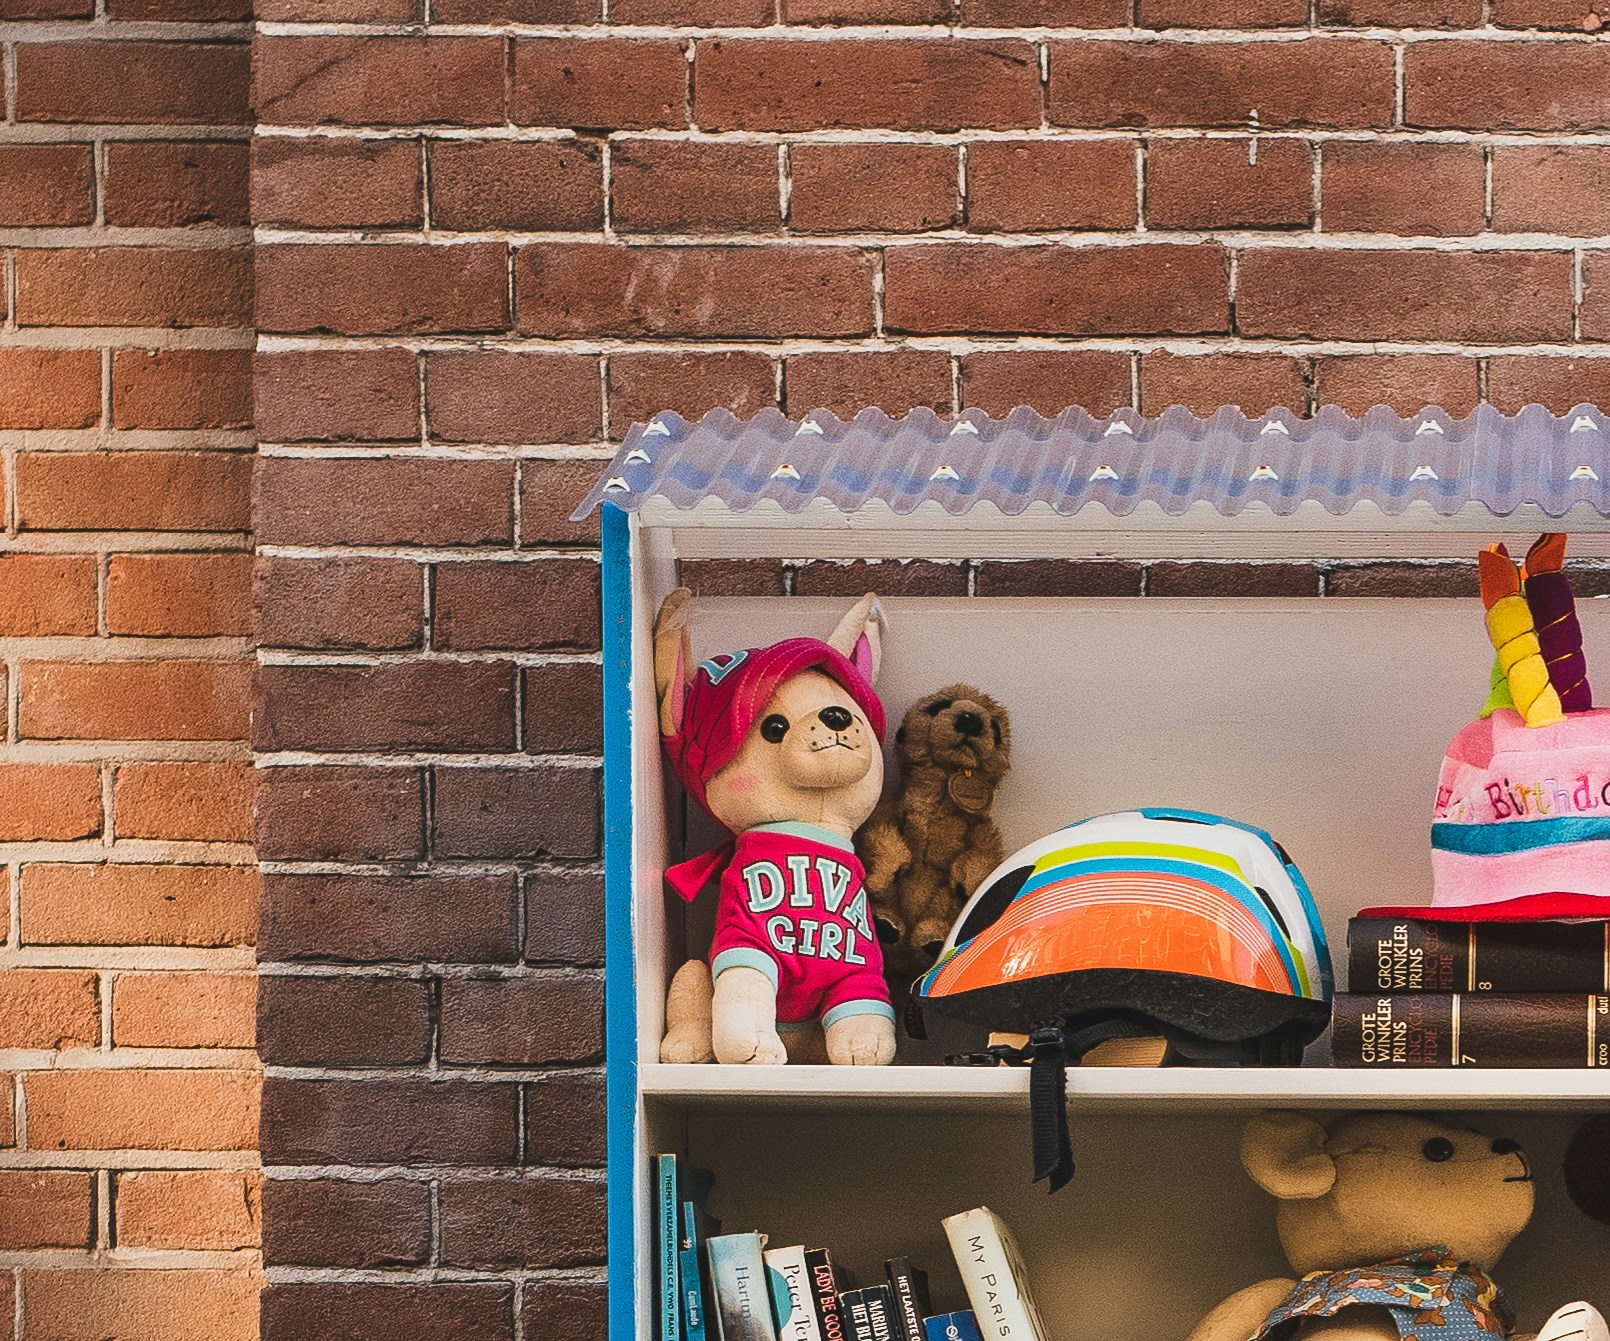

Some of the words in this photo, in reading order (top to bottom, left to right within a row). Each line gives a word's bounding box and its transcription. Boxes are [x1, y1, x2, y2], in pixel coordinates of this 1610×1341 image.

[743, 854, 873, 941] DIVA
[766, 915, 866, 965] GIRL
[1394, 925, 1408, 988] WINKLER
[1378, 940, 1392, 988] GROTE
[1409, 948, 1423, 989] PRINS
[1440, 954, 1453, 989] PEDIE
[1478, 982, 1492, 990] 8
[1362, 1013, 1376, 1062] GROTE
[1377, 998, 1391, 1062] WINKLER
[1393, 1021, 1407, 1062] PRINS
[1462, 1055, 1476, 1063] 7
[1599, 1044, 1608, 1065] croo
[783, 1264, 802, 1311] Peter
[814, 1265, 834, 1293] LADY
[897, 1275, 910, 1293] HET
[968, 1235, 986, 1264] MY
[981, 1273, 1011, 1337] PARIS
[820, 1295, 836, 1313] BE
[851, 1303, 869, 1324] HET
[902, 1292, 919, 1335] LAATSTE
